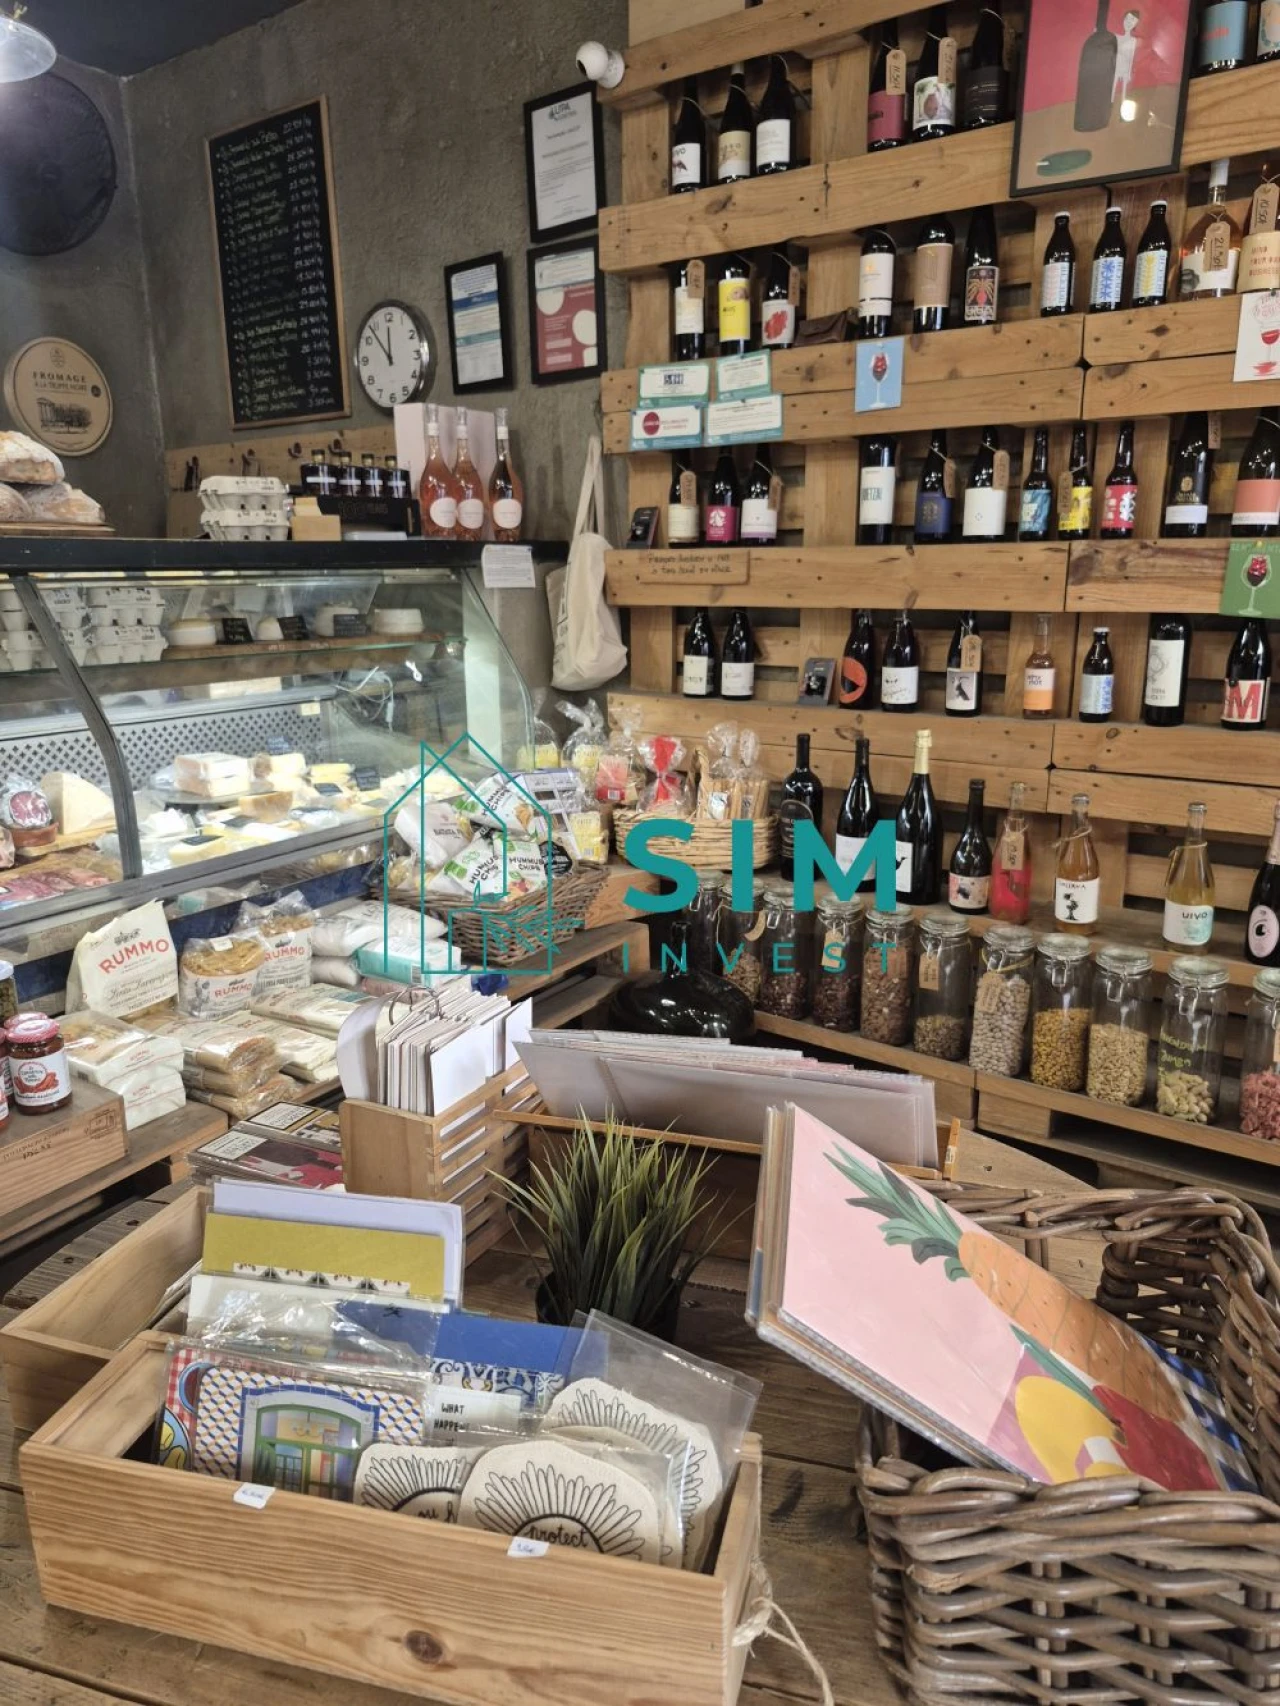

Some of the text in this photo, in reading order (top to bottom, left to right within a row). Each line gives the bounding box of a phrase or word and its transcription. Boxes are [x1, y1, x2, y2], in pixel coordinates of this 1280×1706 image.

[408, 329, 416, 340] 2
[412, 349, 421, 361] 3
[361, 356, 369, 367] 9
[32, 371, 87, 383] FROMAGE
[411, 369, 418, 379] 4
[367, 375, 376, 385] 8
[376, 388, 384, 399] 7
[401, 386, 410, 397] 5
[389, 392, 397, 403] 6
[98, 938, 170, 974] RUMMO
[264, 946, 305, 962] RUMMO
[214, 983, 253, 998] RUMMO
[441, 1402, 465, 1415] WHAT
